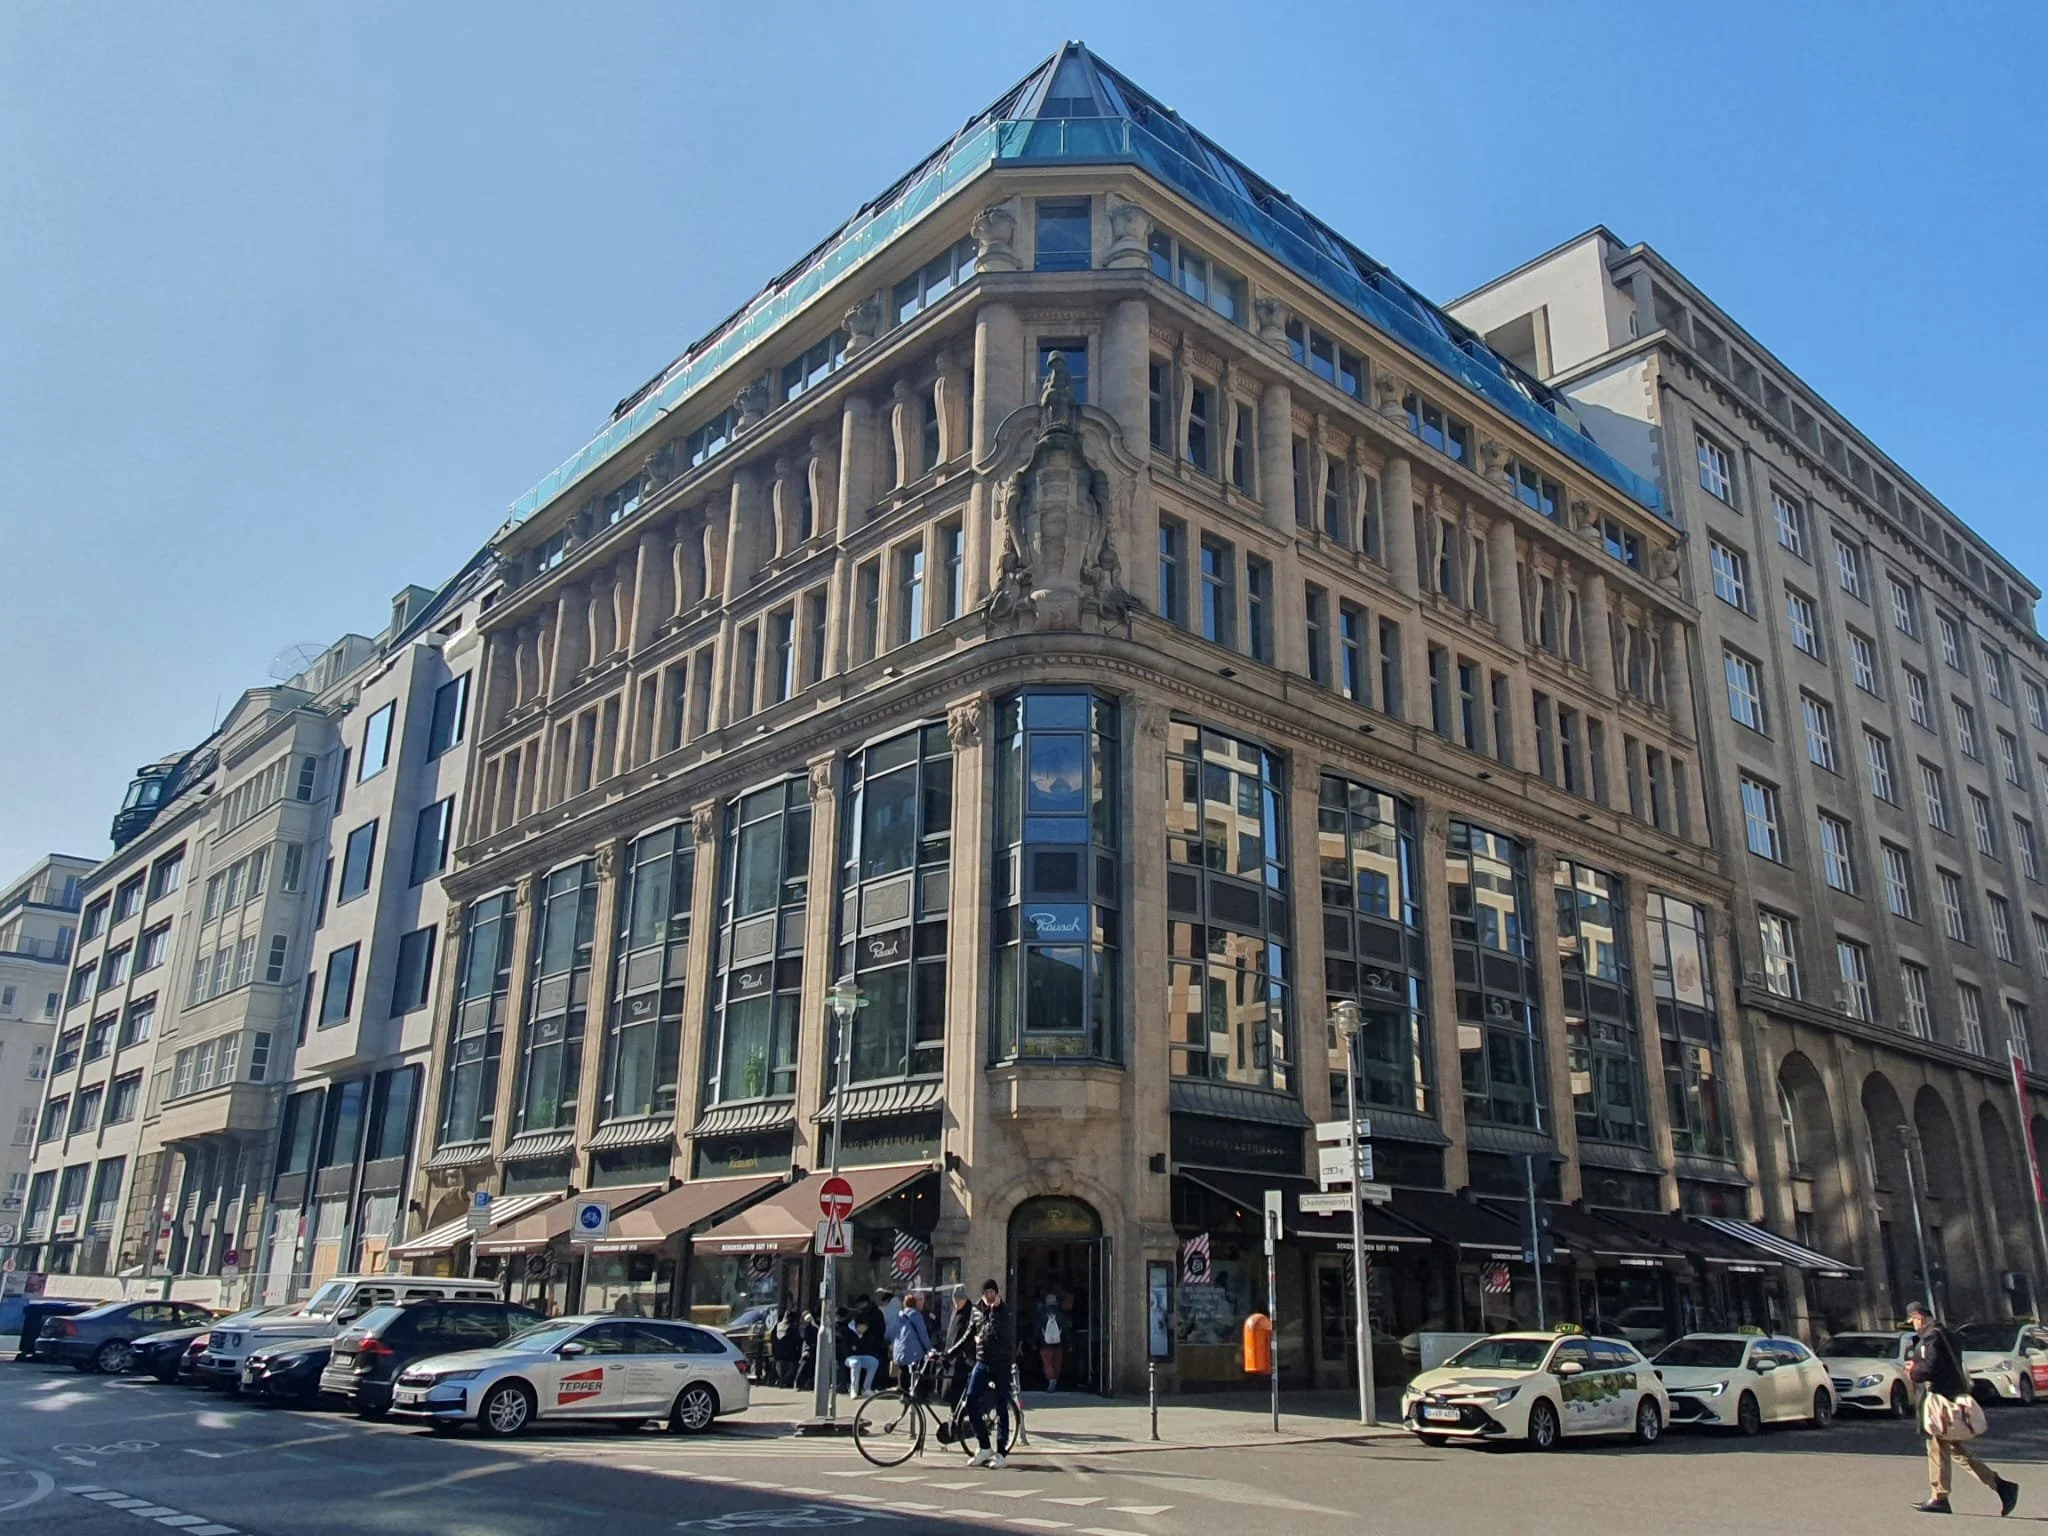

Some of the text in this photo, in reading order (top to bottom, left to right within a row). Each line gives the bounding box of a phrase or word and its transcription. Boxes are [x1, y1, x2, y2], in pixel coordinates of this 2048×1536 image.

[1029, 912, 1081, 932] Rausch
[869, 940, 899, 959] Rausch
[559, 1381, 603, 1391] TEPPER
